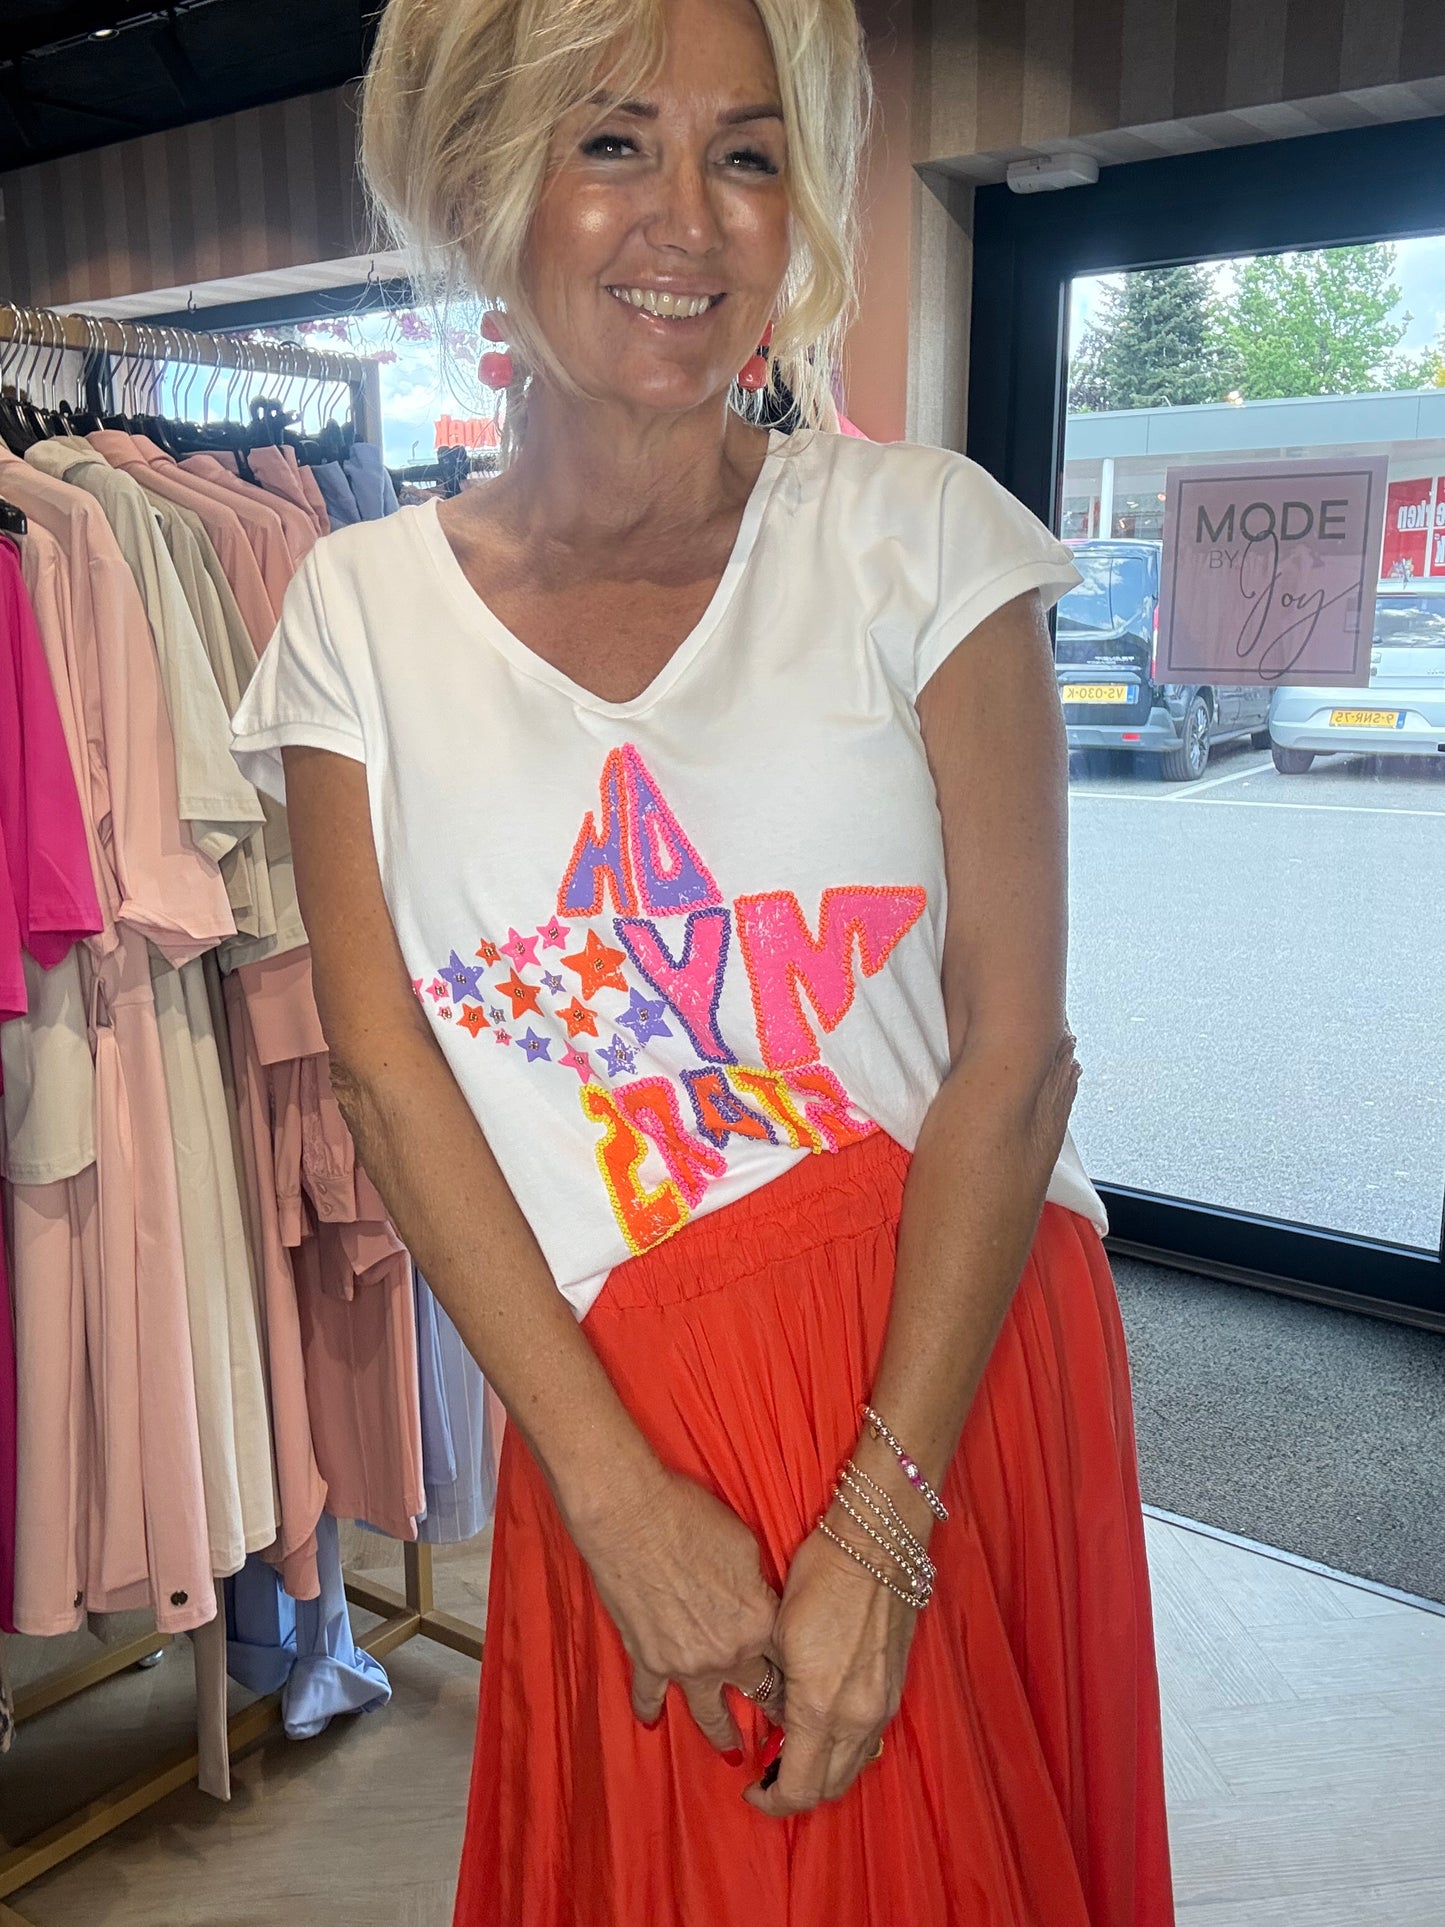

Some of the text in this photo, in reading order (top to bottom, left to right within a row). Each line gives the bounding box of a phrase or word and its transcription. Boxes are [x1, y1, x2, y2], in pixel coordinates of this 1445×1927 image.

[1195, 499, 1349, 544] MODE
[1209, 529, 1363, 680] BY Joy
